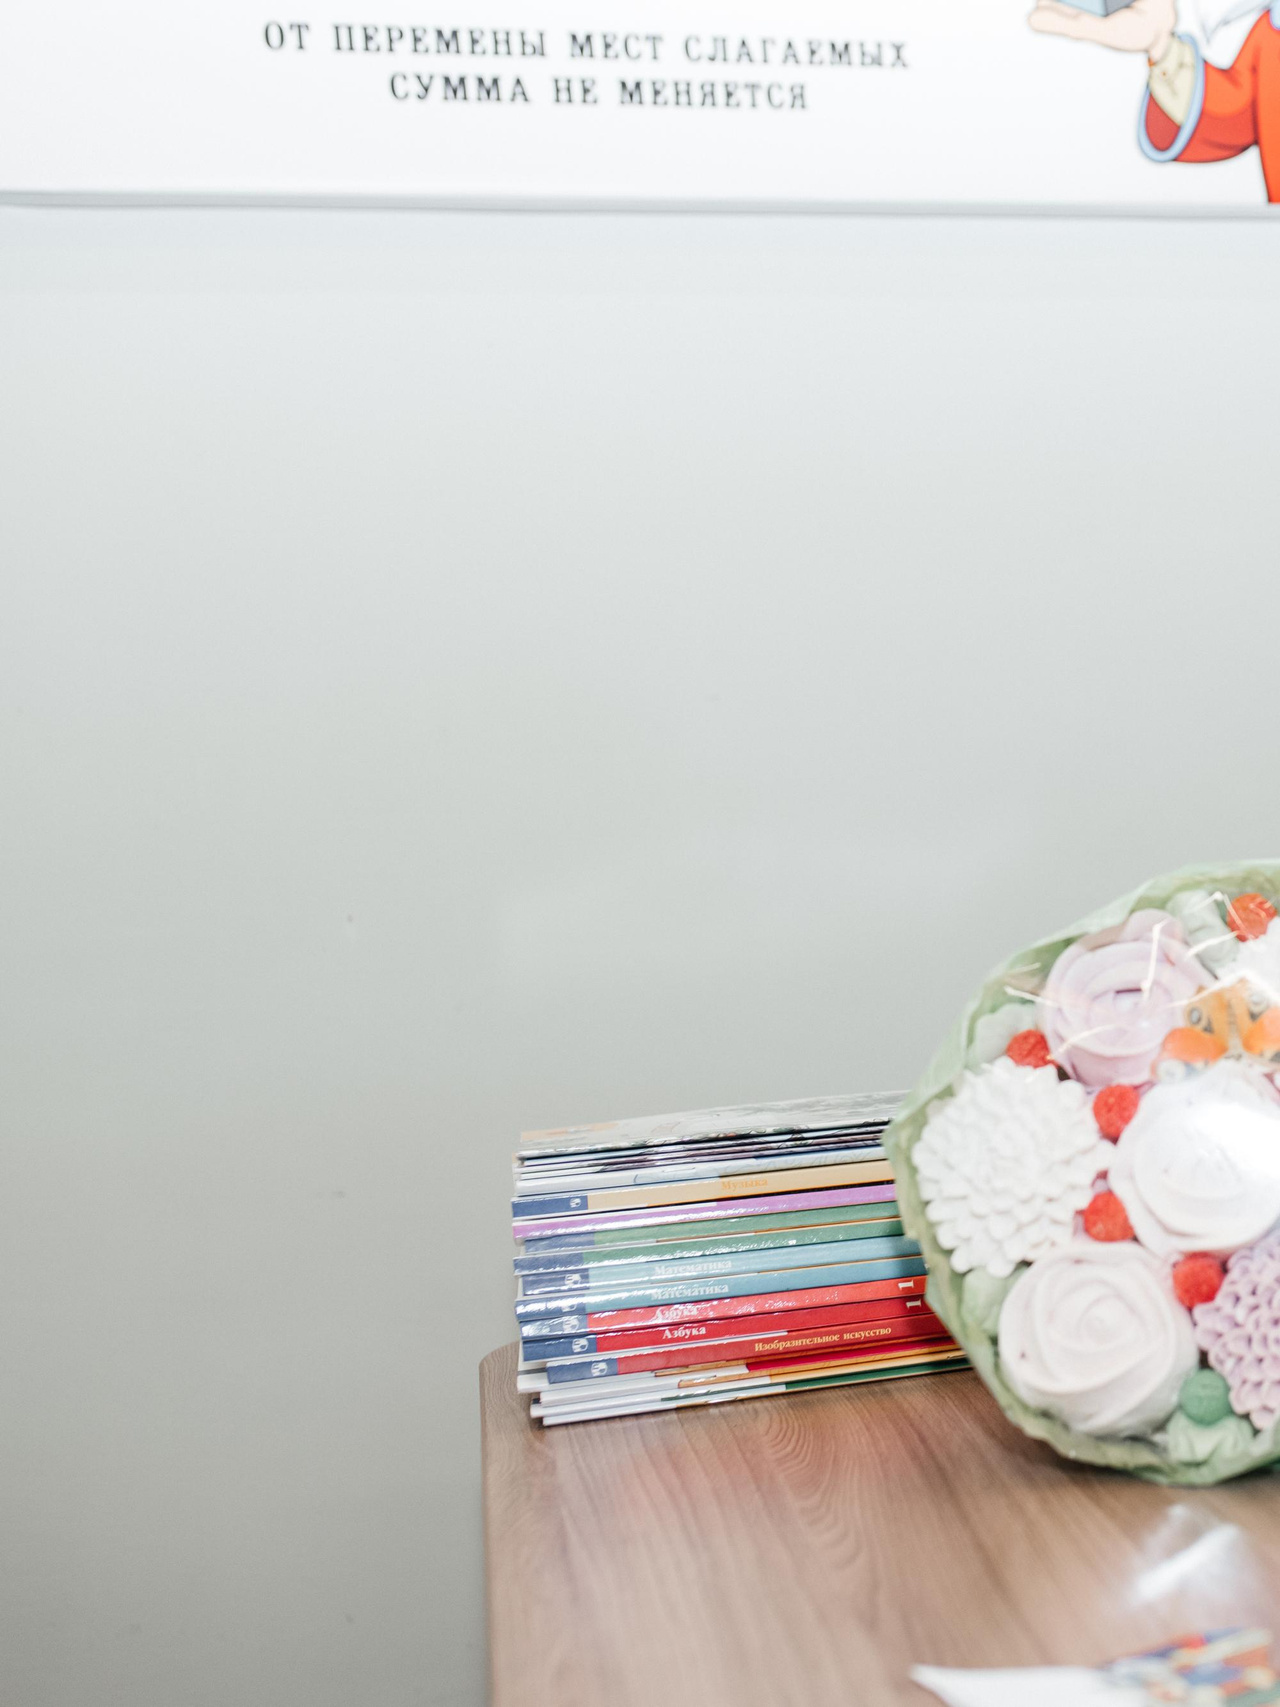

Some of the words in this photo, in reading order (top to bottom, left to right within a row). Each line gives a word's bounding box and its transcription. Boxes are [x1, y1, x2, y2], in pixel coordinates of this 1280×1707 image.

[263, 21, 310, 51] ОТ
[333, 24, 546, 57] ПЕРЕМЕНЫ
[569, 33, 664, 61] МЕСТ
[684, 35, 908, 68] СЛАГАЕМЫХ
[390, 72, 530, 103] СУММА
[553, 77, 598, 104] НЕ
[619, 79, 808, 110] МЕНЯЕТСЯ
[721, 1177, 768, 1191] Музыка
[654, 1260, 732, 1275] Математика
[651, 1284, 729, 1300] Математика
[656, 1303, 698, 1319] Азбука
[662, 1326, 706, 1339] Азбука
[755, 1333, 840, 1351] Изобразительное
[843, 1327, 892, 1341] искусство
